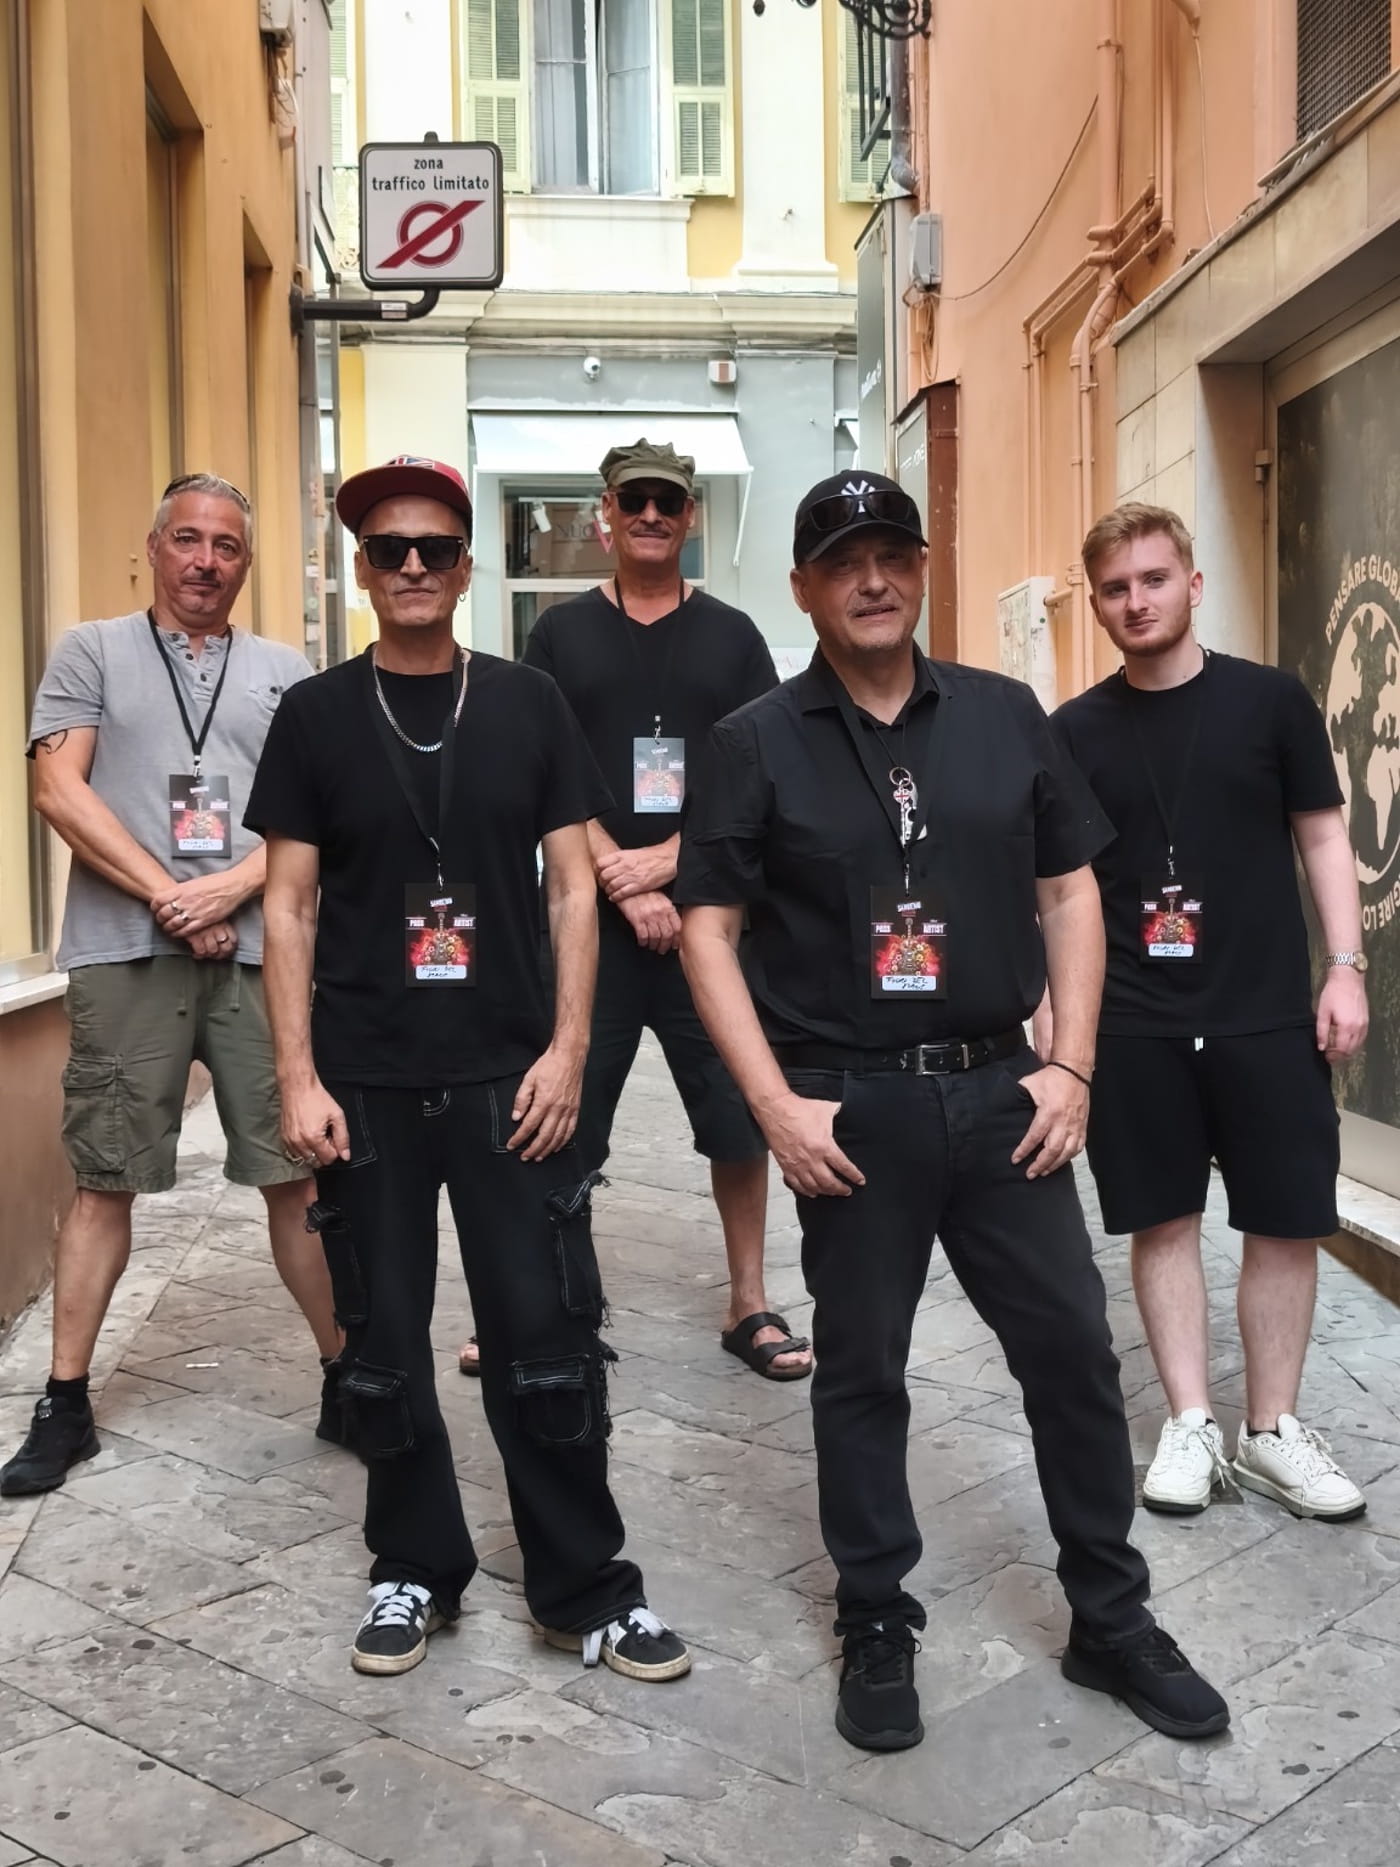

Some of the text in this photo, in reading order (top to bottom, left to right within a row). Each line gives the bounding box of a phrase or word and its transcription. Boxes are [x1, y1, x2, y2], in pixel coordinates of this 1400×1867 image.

[414, 158, 444, 170] zona
[372, 175, 490, 191] traffico limitato
[1325, 556, 1367, 646] PENSARE
[1378, 873, 1400, 929] GIRE
